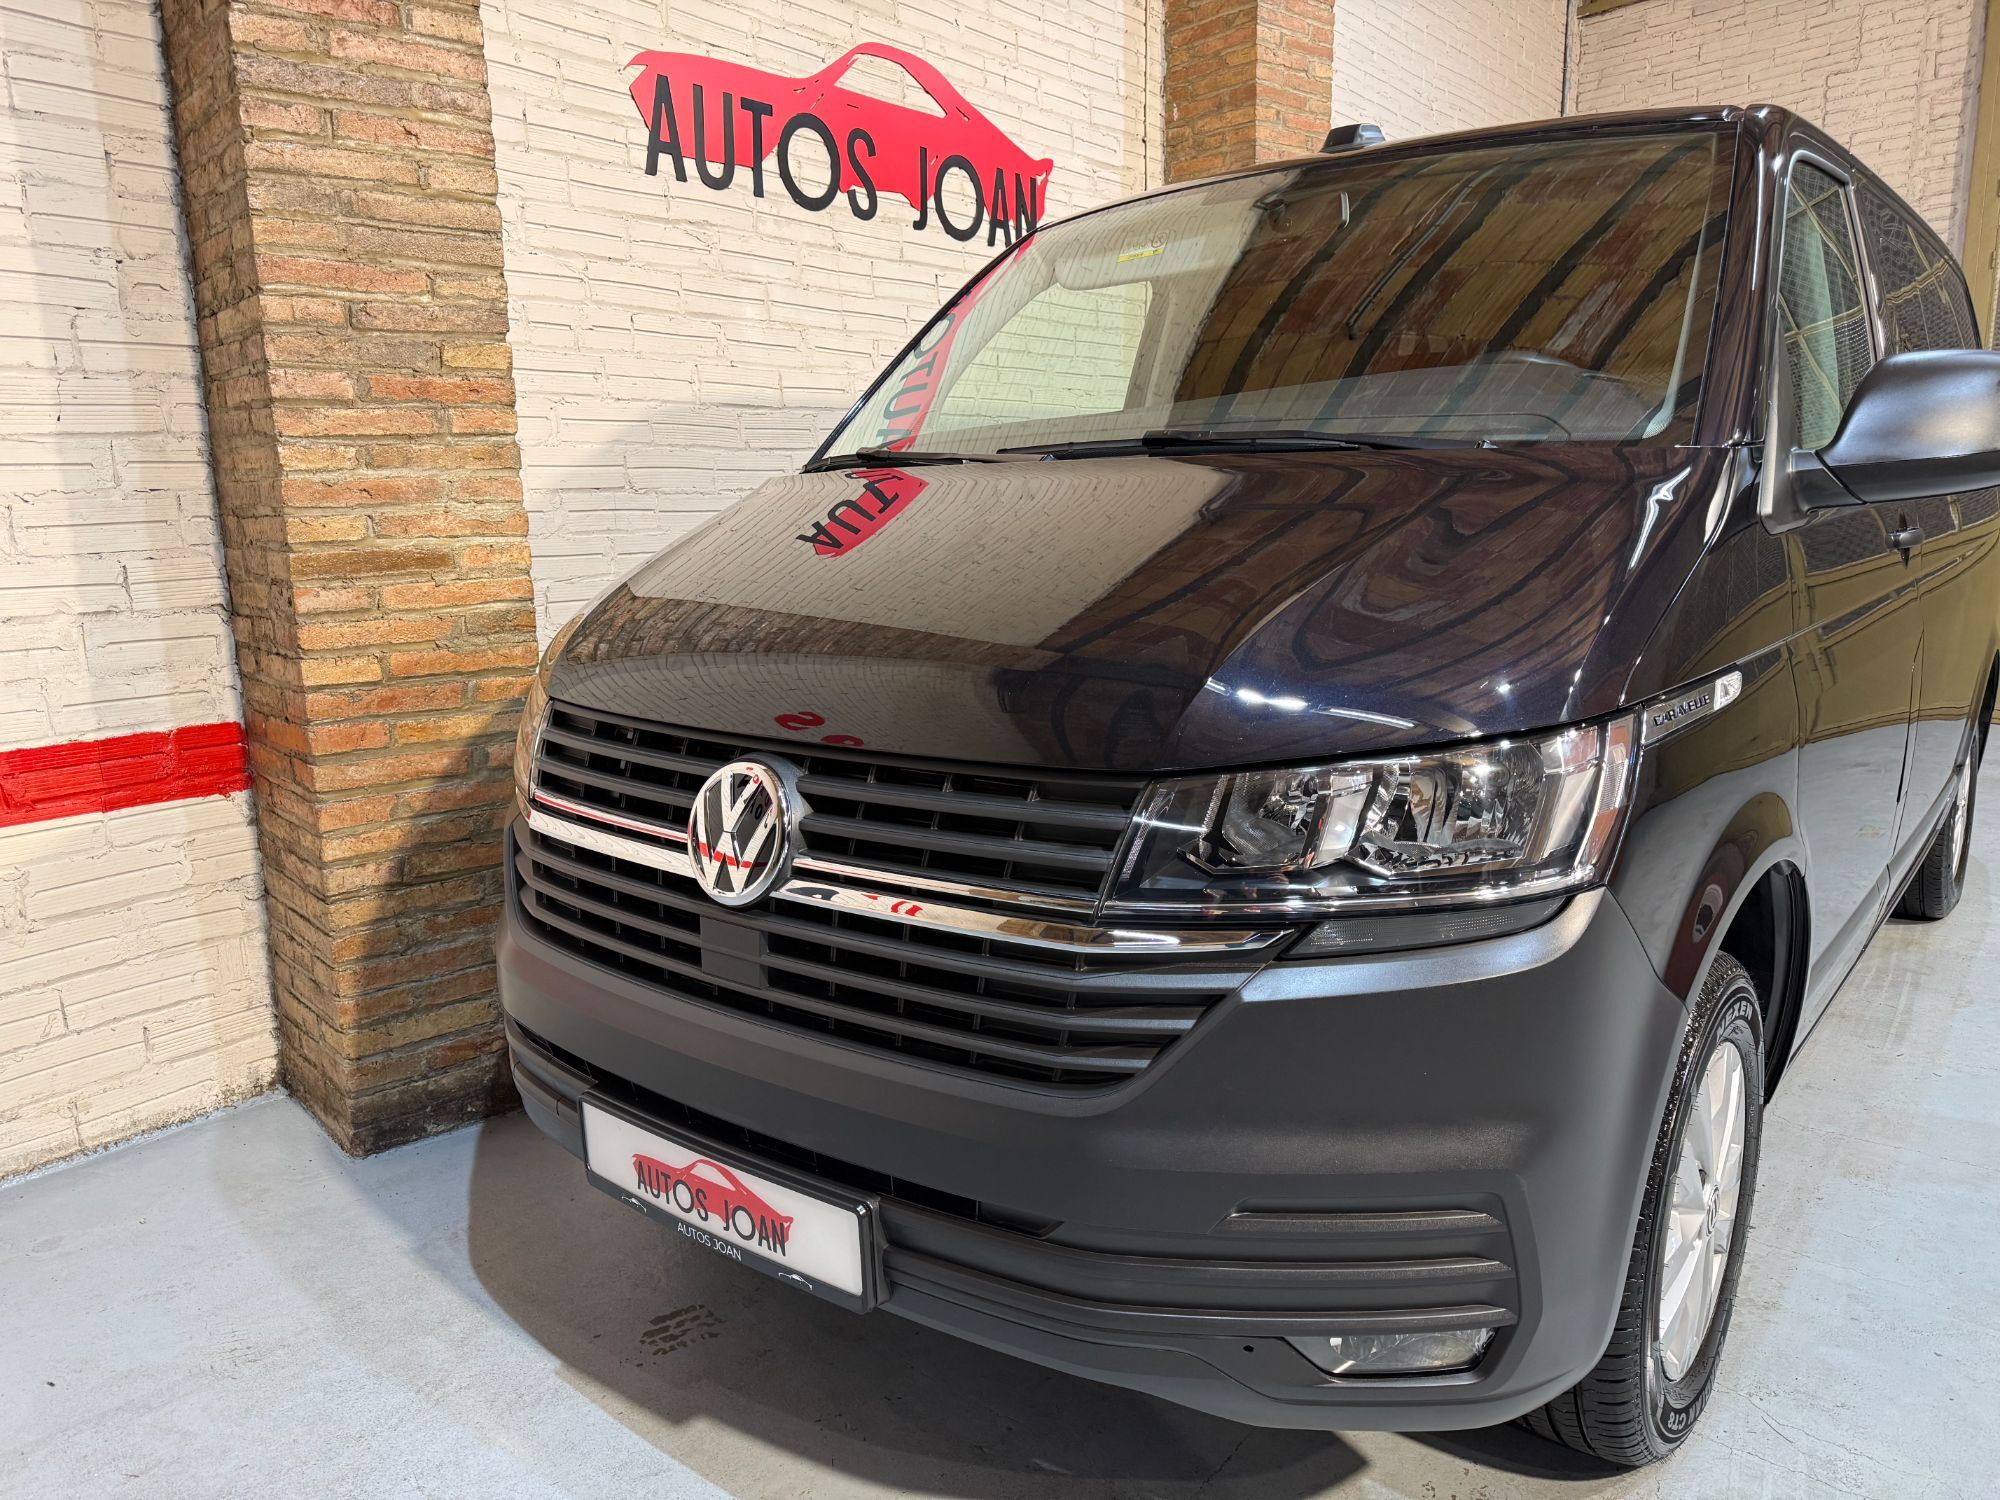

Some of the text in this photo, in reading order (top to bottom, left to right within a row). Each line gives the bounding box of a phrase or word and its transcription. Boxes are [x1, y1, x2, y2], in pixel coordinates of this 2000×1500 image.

[645, 73, 1038, 248] AUTOS JOAN
[1652, 694, 1711, 727] CARAVELLE
[690, 764, 782, 898] VW
[1716, 1000, 1753, 1043] NEXEN
[637, 1160, 786, 1257] AUTOS JOAN
[677, 1222, 742, 1262] AUTOS JOAN
[1667, 1411, 1687, 1431] CT8
